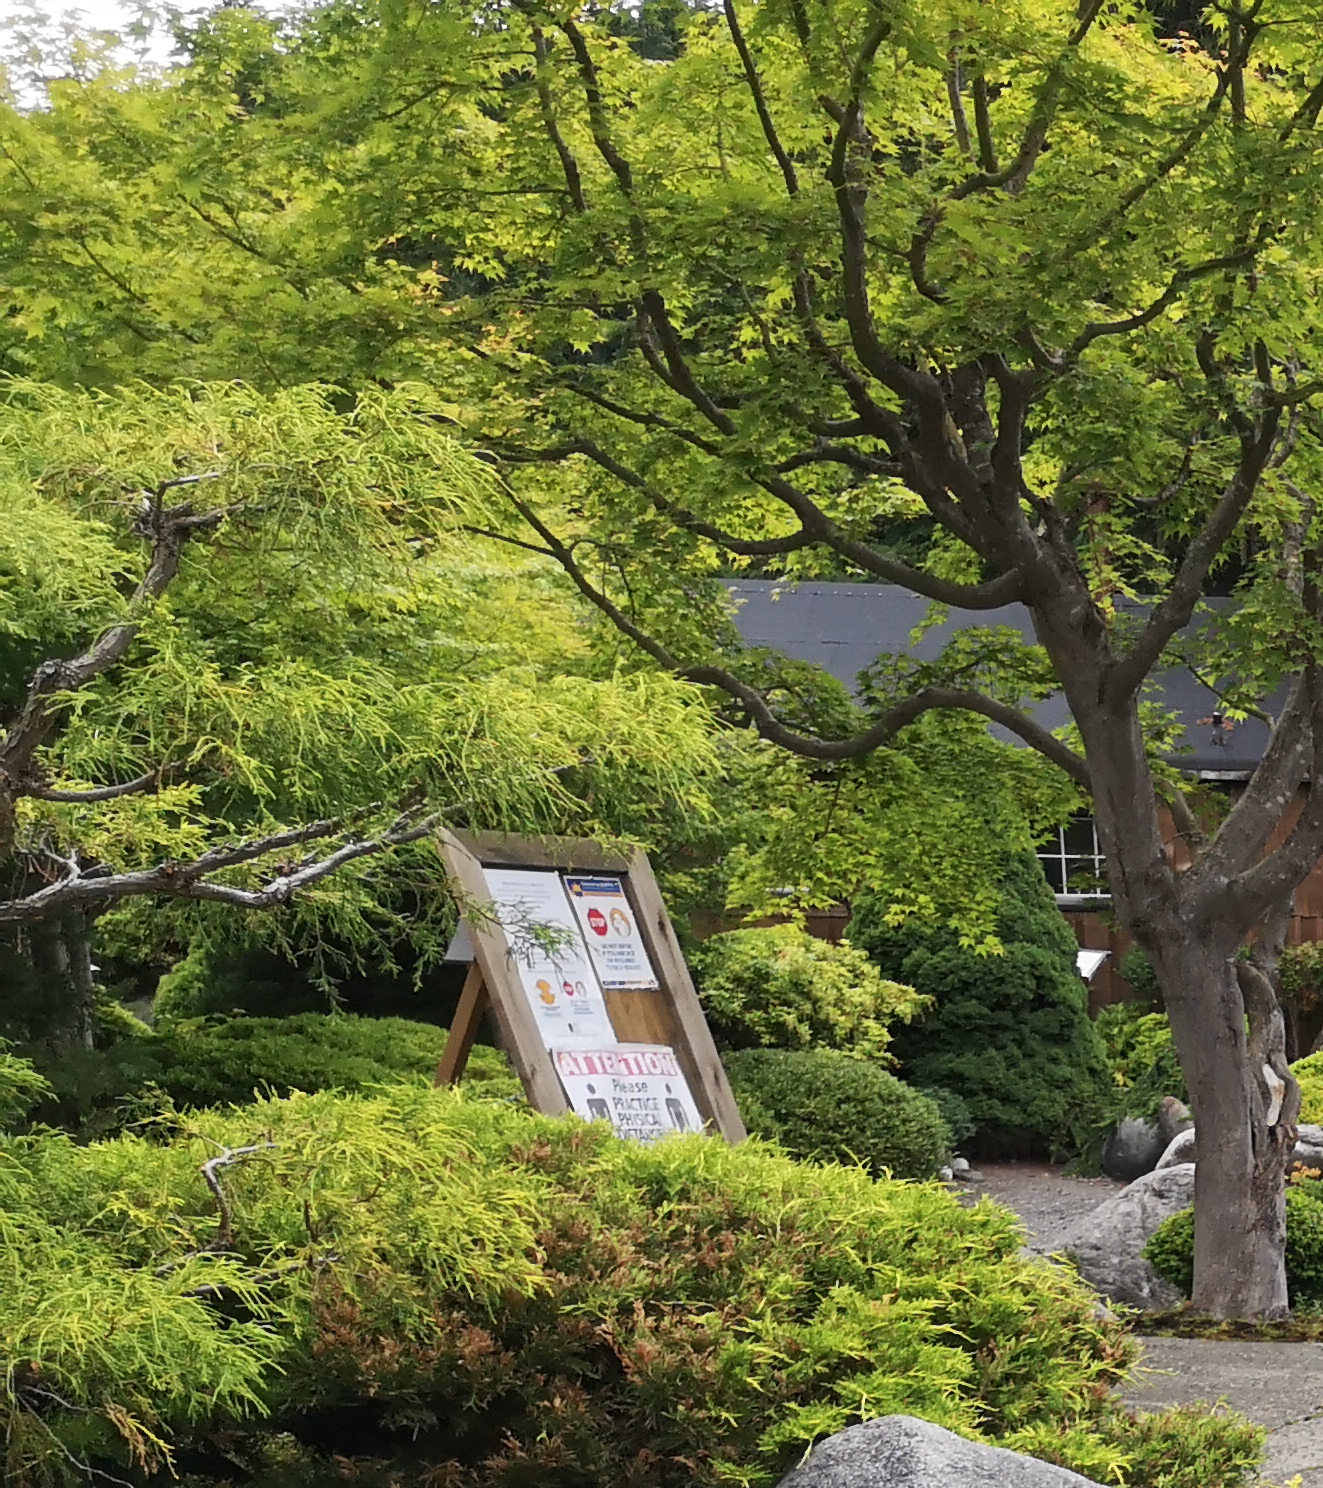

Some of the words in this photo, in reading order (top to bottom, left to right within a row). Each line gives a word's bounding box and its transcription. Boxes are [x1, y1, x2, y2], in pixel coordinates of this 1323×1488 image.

[557, 1051, 679, 1077] ATTENTION
[612, 1078, 648, 1093] Please
[612, 1097, 660, 1112] PRACTICE
